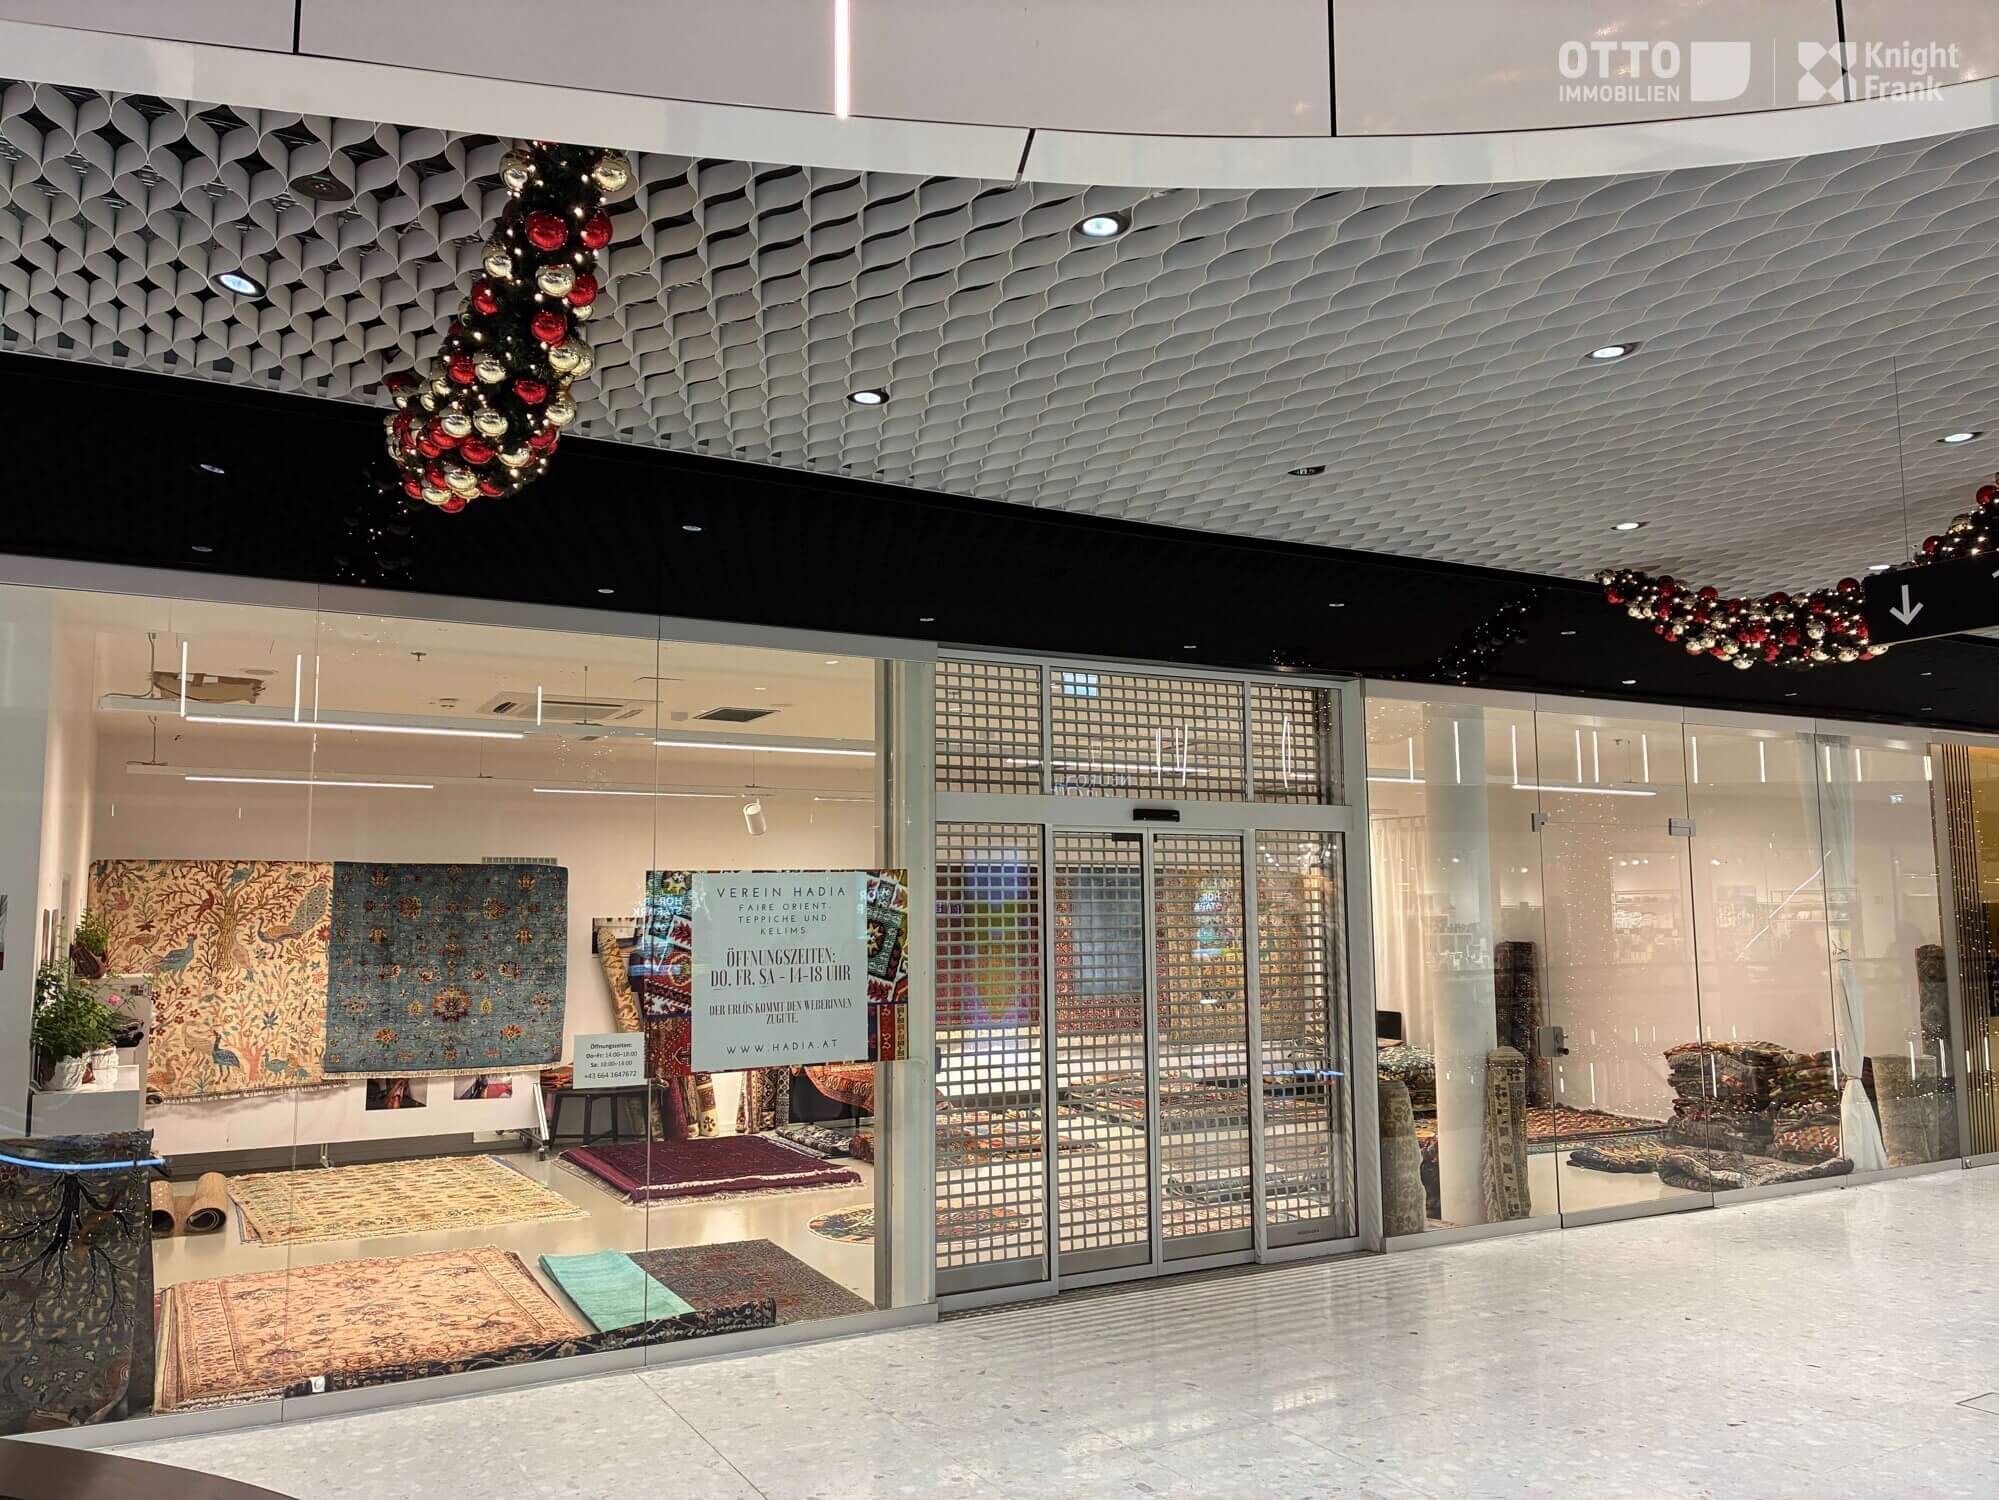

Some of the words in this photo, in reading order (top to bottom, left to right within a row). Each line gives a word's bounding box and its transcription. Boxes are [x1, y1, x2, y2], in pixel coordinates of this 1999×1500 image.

[716, 887, 782, 898] VEREIN
[793, 886, 847, 897] HADIA
[738, 903, 776, 912] FAIRE
[738, 914, 797, 925] TEPPICHE
[803, 913, 828, 922] UND
[760, 926, 806, 936] KELIMS
[726, 947, 836, 968] ÖFFNUNGSZEITEN:
[760, 967, 775, 985] SA
[790, 965, 823, 983] 14-18
[826, 964, 851, 981] UHR
[709, 1004, 726, 1016] DER
[727, 1001, 754, 1015] ERLÖS
[755, 1000, 784, 1013] KOMMT
[786, 999, 802, 1012] DEN
[803, 997, 853, 1011] WEBERINNEN
[726, 1038, 839, 1054] WWW.HADIA.AT
